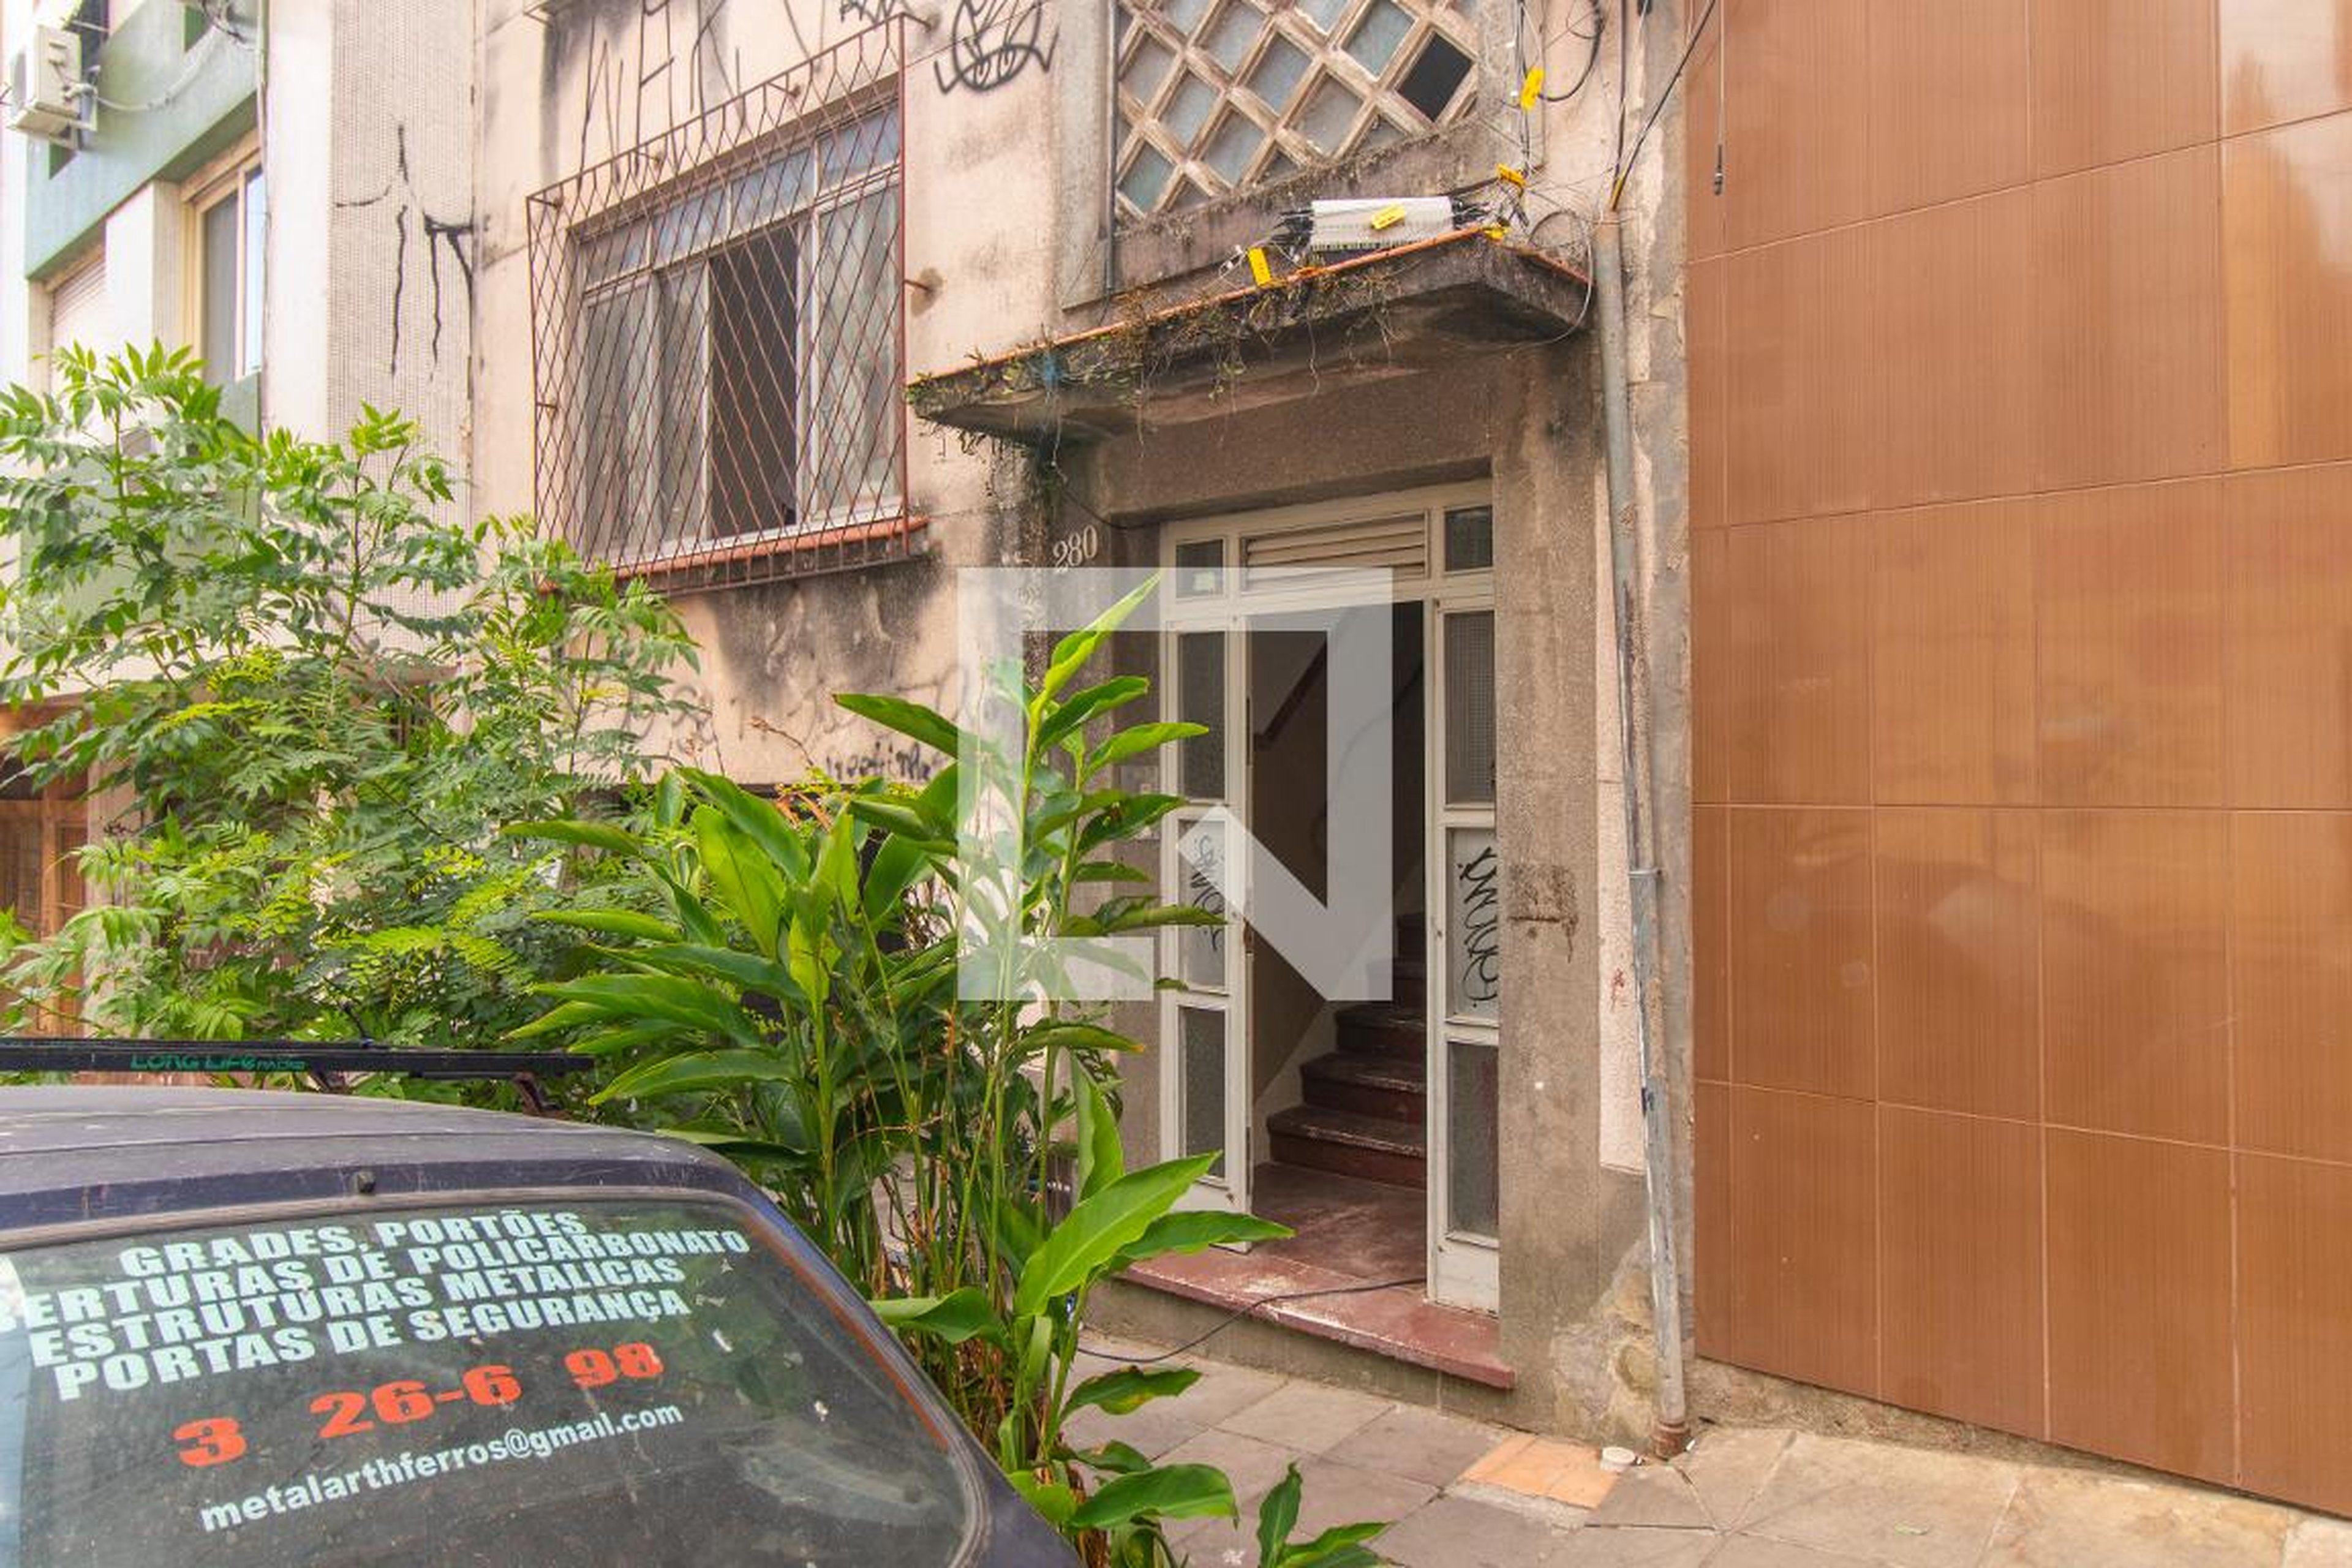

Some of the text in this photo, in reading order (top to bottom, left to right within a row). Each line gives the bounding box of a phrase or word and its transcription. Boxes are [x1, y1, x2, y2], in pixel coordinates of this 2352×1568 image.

[1054, 524, 1098, 573] 280
[119, 1209, 587, 1277] GRADES, PORTÕES
[322, 1252, 396, 1284] DE
[408, 1230, 750, 1275] POLICARBONATO
[29, 1277, 434, 1367] ESTRUTURAS
[54, 1290, 692, 1401] PORTAS DE SEGURANÇA
[199, 1405, 684, 1532] metalarthferros@gmail.com
